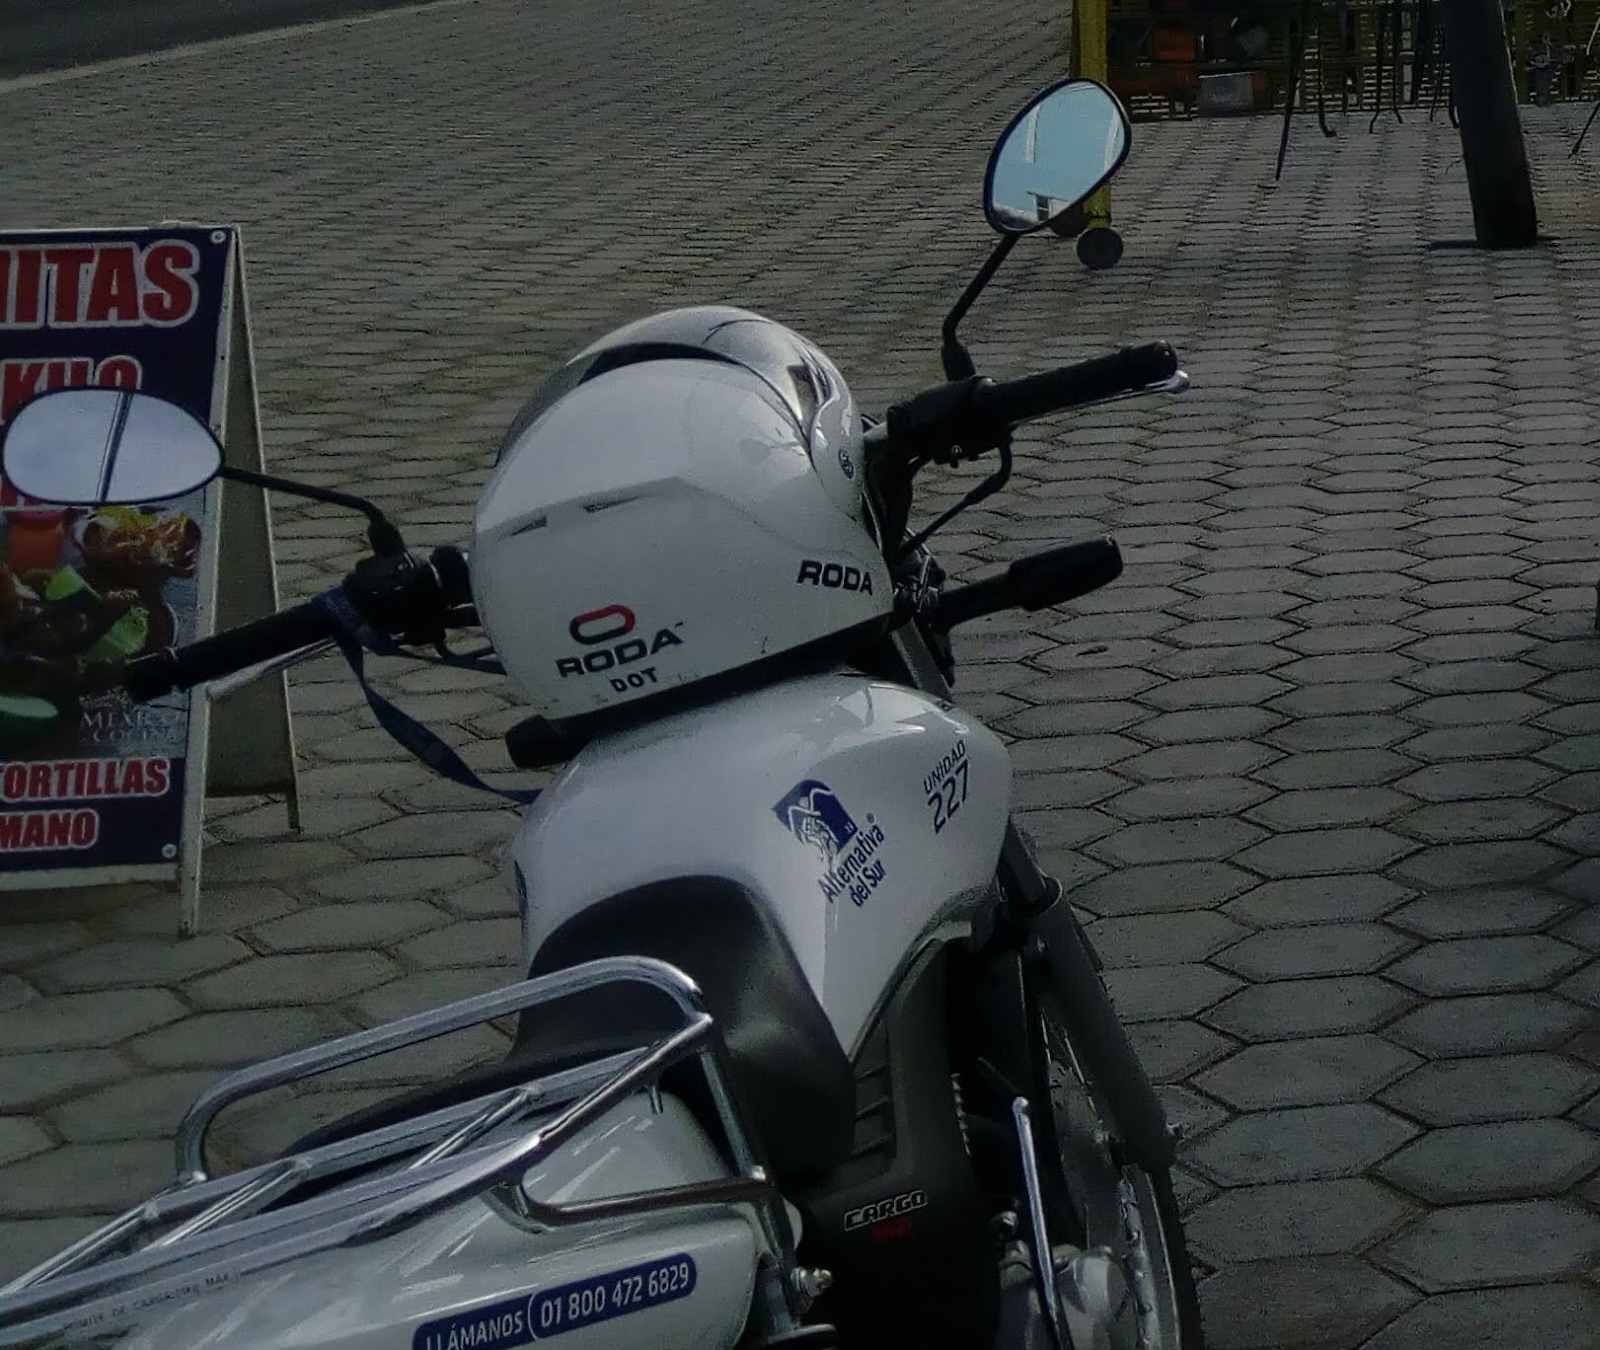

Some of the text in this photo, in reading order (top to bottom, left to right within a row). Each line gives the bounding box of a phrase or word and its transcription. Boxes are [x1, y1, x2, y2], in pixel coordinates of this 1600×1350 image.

[0, 240, 200, 328] ITAS
[797, 559, 873, 596] RODA
[555, 626, 684, 678] RODA
[611, 666, 658, 693] DOT
[0, 759, 168, 799] ORTILLAS
[923, 739, 966, 795] UNIDAD
[928, 759, 968, 835] 227
[818, 824, 885, 903] Alternativa
[849, 859, 887, 907] del Sur
[843, 1189, 929, 1232] CARGO
[540, 1296, 563, 1328] 01
[567, 1286, 606, 1320] 800
[611, 1275, 643, 1309] 472
[648, 1262, 689, 1298] 6829
